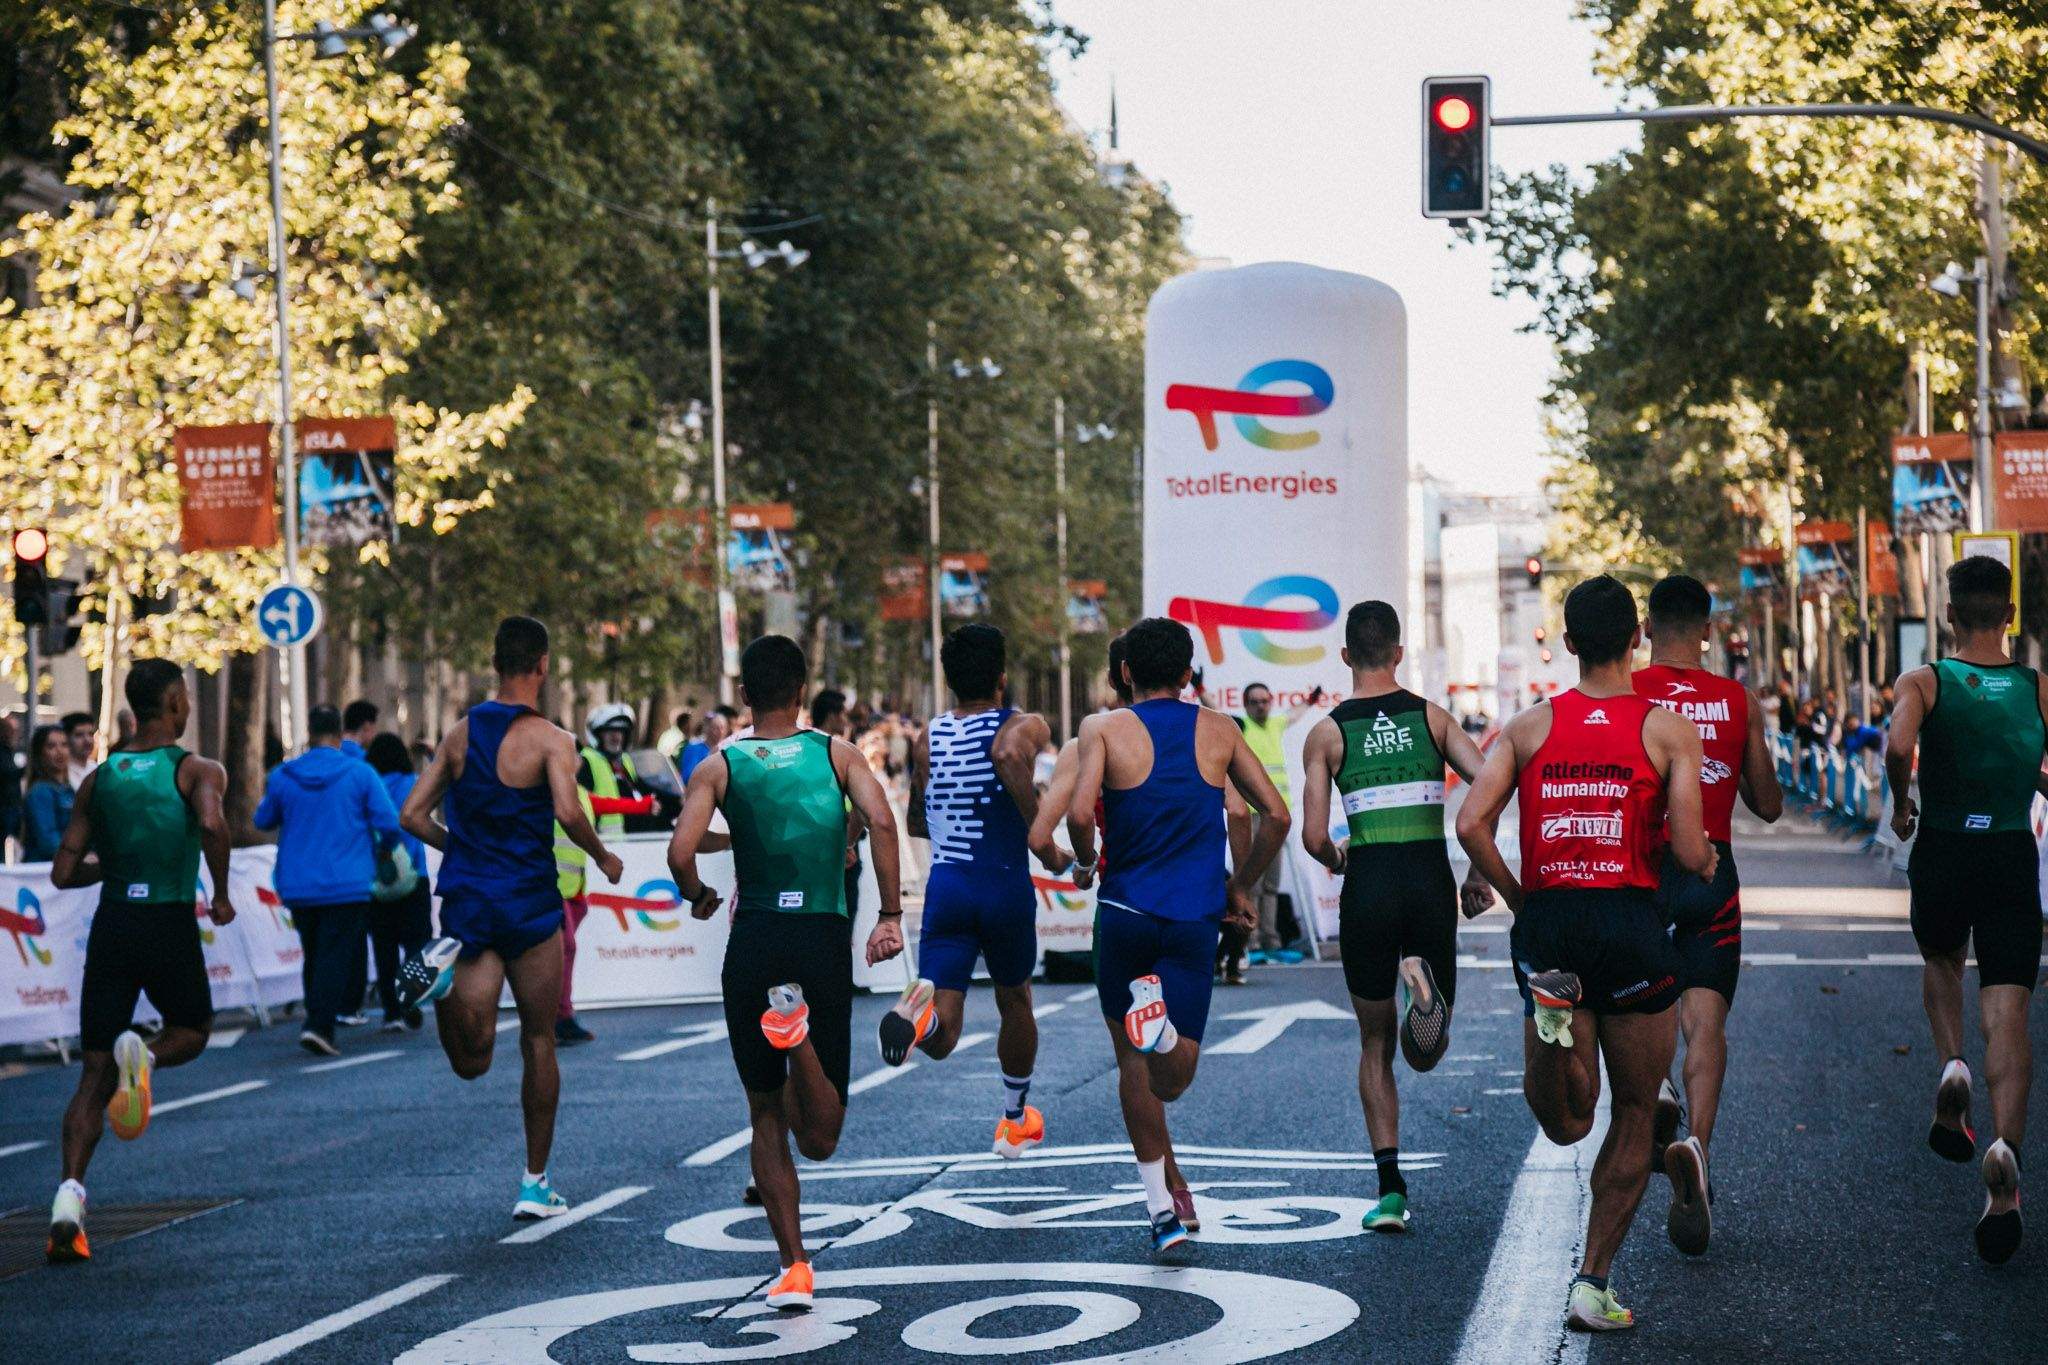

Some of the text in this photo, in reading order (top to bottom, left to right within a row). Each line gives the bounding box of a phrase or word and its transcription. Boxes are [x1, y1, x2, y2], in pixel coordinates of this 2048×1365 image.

[1166, 470, 1338, 500] TotalEnergies
[1681, 698, 1731, 721] CAMÍ
[1364, 727, 1413, 748] AIRE
[1364, 742, 1414, 757] SPORT
[1541, 761, 1634, 782] Atletismo
[1541, 780, 1629, 799] Numantino
[1595, 837, 1622, 847] SORIA
[1593, 860, 1624, 873] LEÓN
[626, 1291, 1141, 1363] 30
